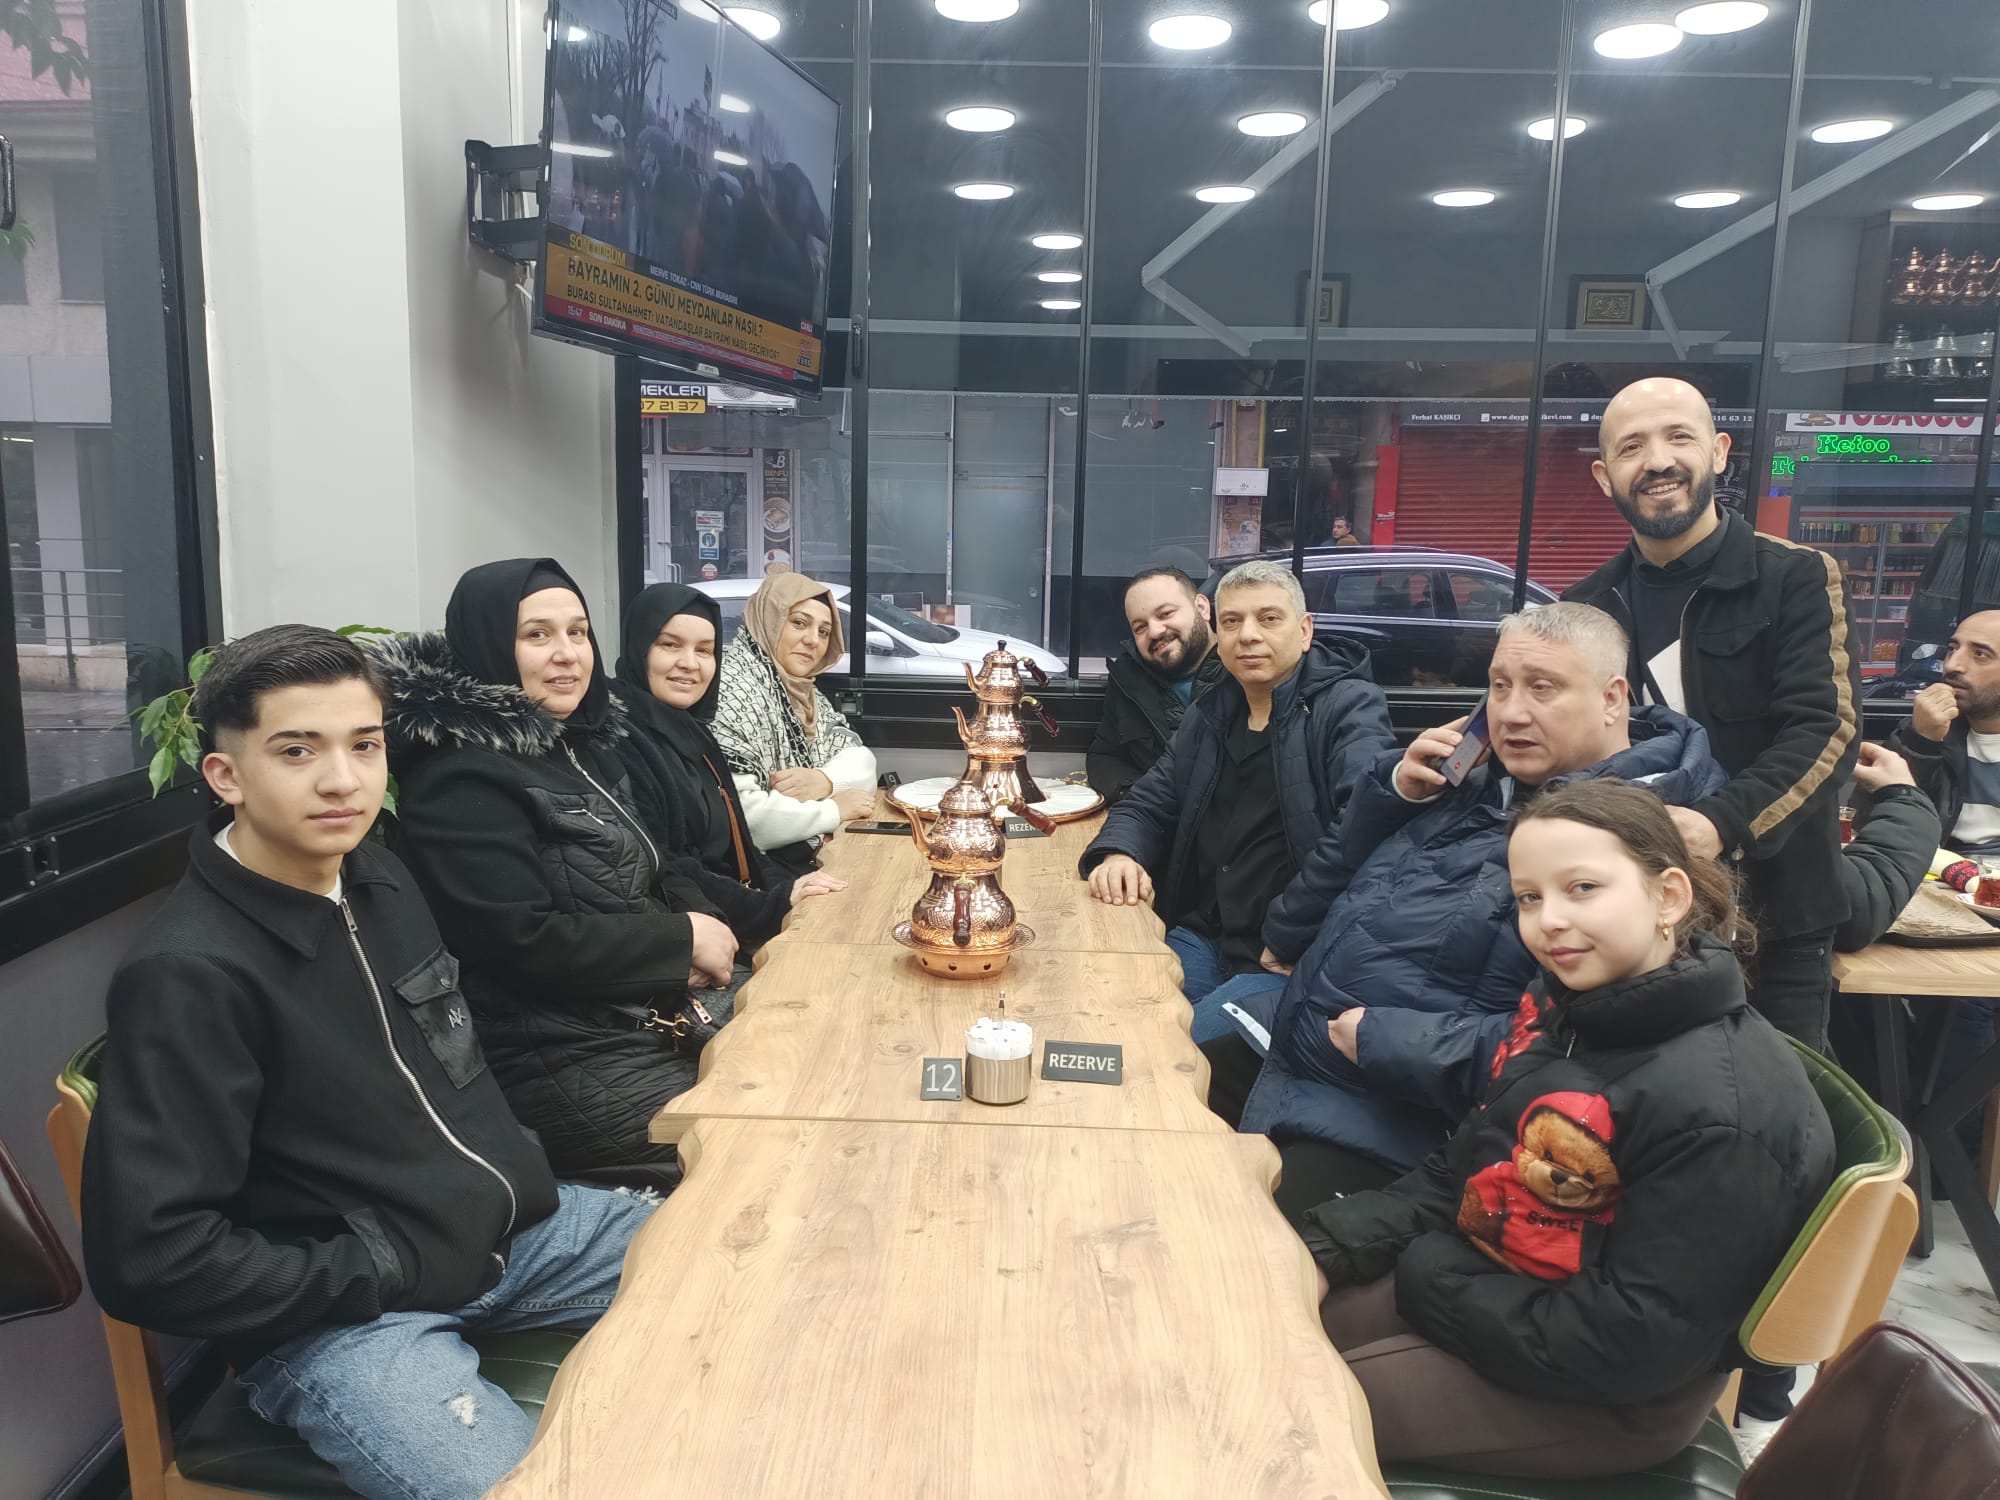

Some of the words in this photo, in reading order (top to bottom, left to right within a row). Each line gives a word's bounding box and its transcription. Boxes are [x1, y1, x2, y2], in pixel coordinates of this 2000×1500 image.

[570, 233, 588, 252] SON
[650, 265, 669, 280] MERVE
[568, 257, 630, 294] BAYRAMIN
[632, 280, 641, 298] 2.
[645, 282, 675, 309] GÜNÜ
[677, 296, 733, 328] MEYDANLAR
[735, 315, 763, 337] NASIL?
[567, 285, 596, 304] BURASI
[655, 312, 703, 336] VATANDAŞLAR
[704, 326, 731, 345] BAYRAMI
[589, 311, 603, 323] SON
[660, 401, 673, 411] 21
[678, 401, 699, 411] 37
[1411, 413, 1433, 421] Ferhat
[1816, 434, 1891, 453] Kefoo
[1009, 823, 1037, 833] REZER
[1049, 1053, 1116, 1072] REZERVE
[926, 1063, 957, 1092] 12
